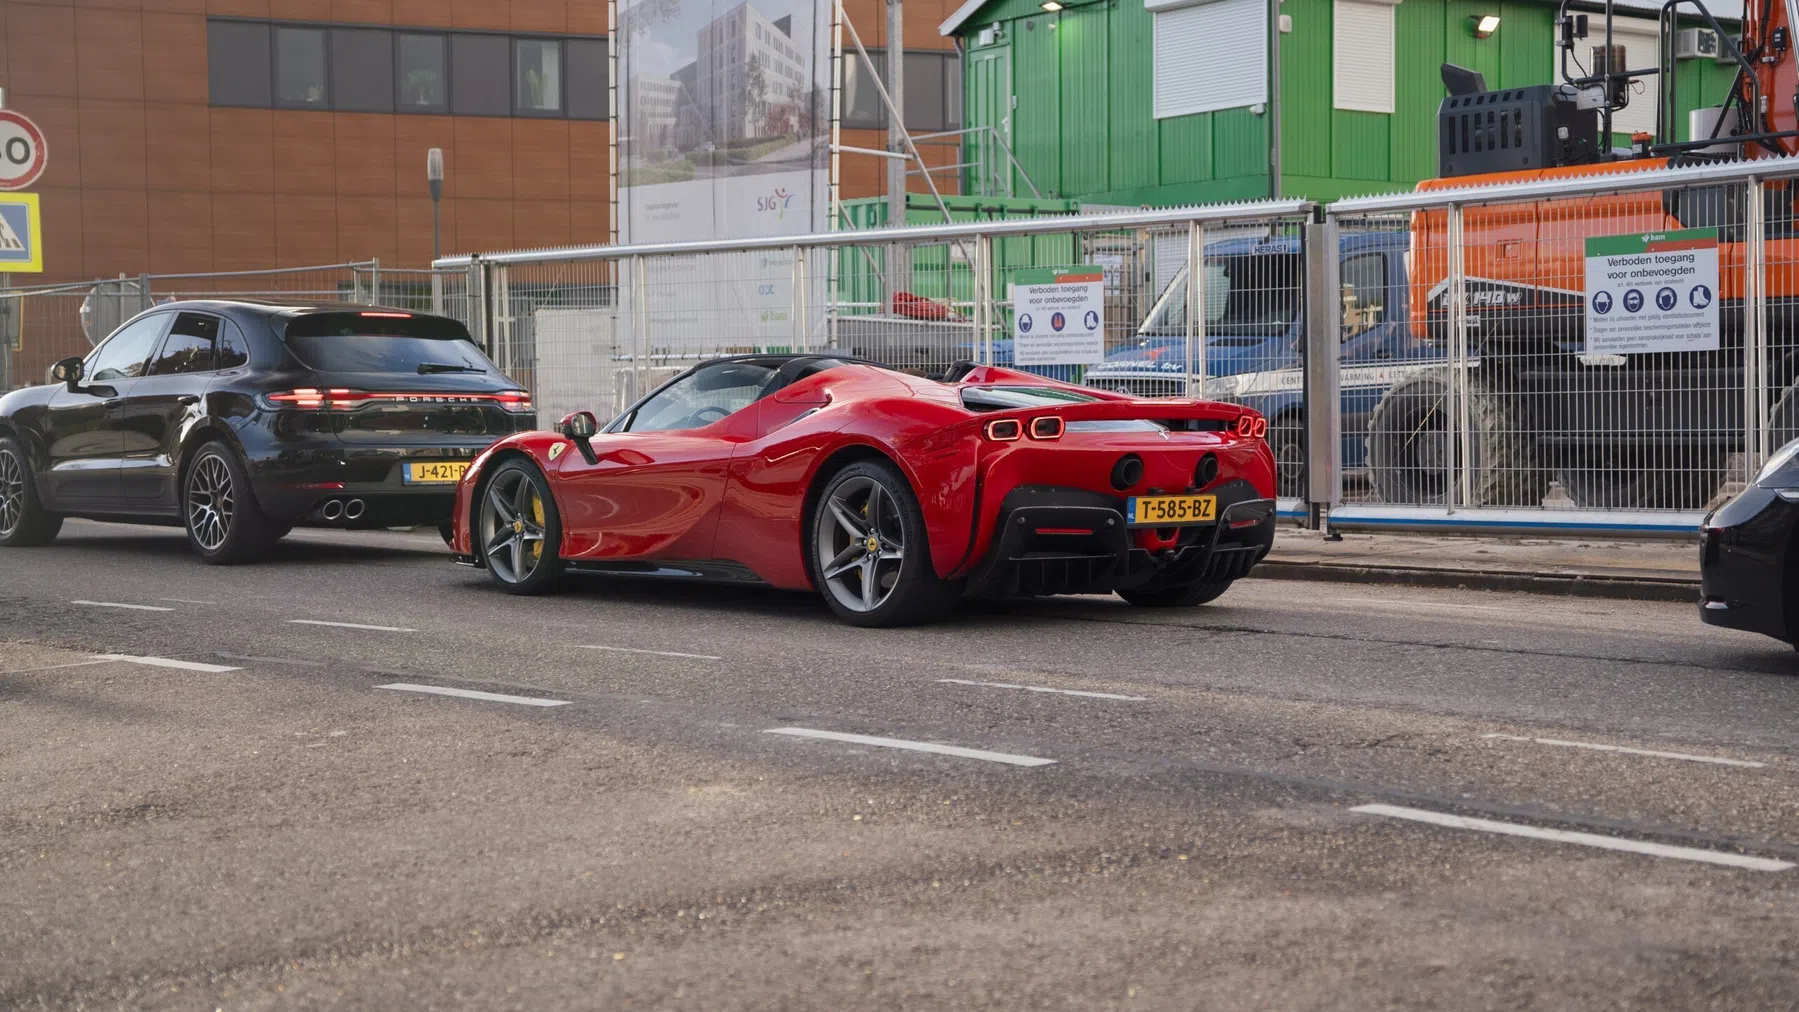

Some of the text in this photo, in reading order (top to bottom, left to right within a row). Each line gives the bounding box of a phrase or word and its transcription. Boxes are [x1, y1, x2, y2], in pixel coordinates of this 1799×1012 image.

[0, 136, 31, 165] 0
[757, 196, 777, 212] SJG
[1254, 245, 1283, 254] HERAS
[1607, 254, 1695, 267] Verboden toegang
[1607, 266, 1695, 280] voor onbevoegden
[1029, 285, 1088, 294] Verboden toegang
[1044, 295, 1088, 304] onbevoegden
[1142, 499, 1212, 519] T-585-BZ
